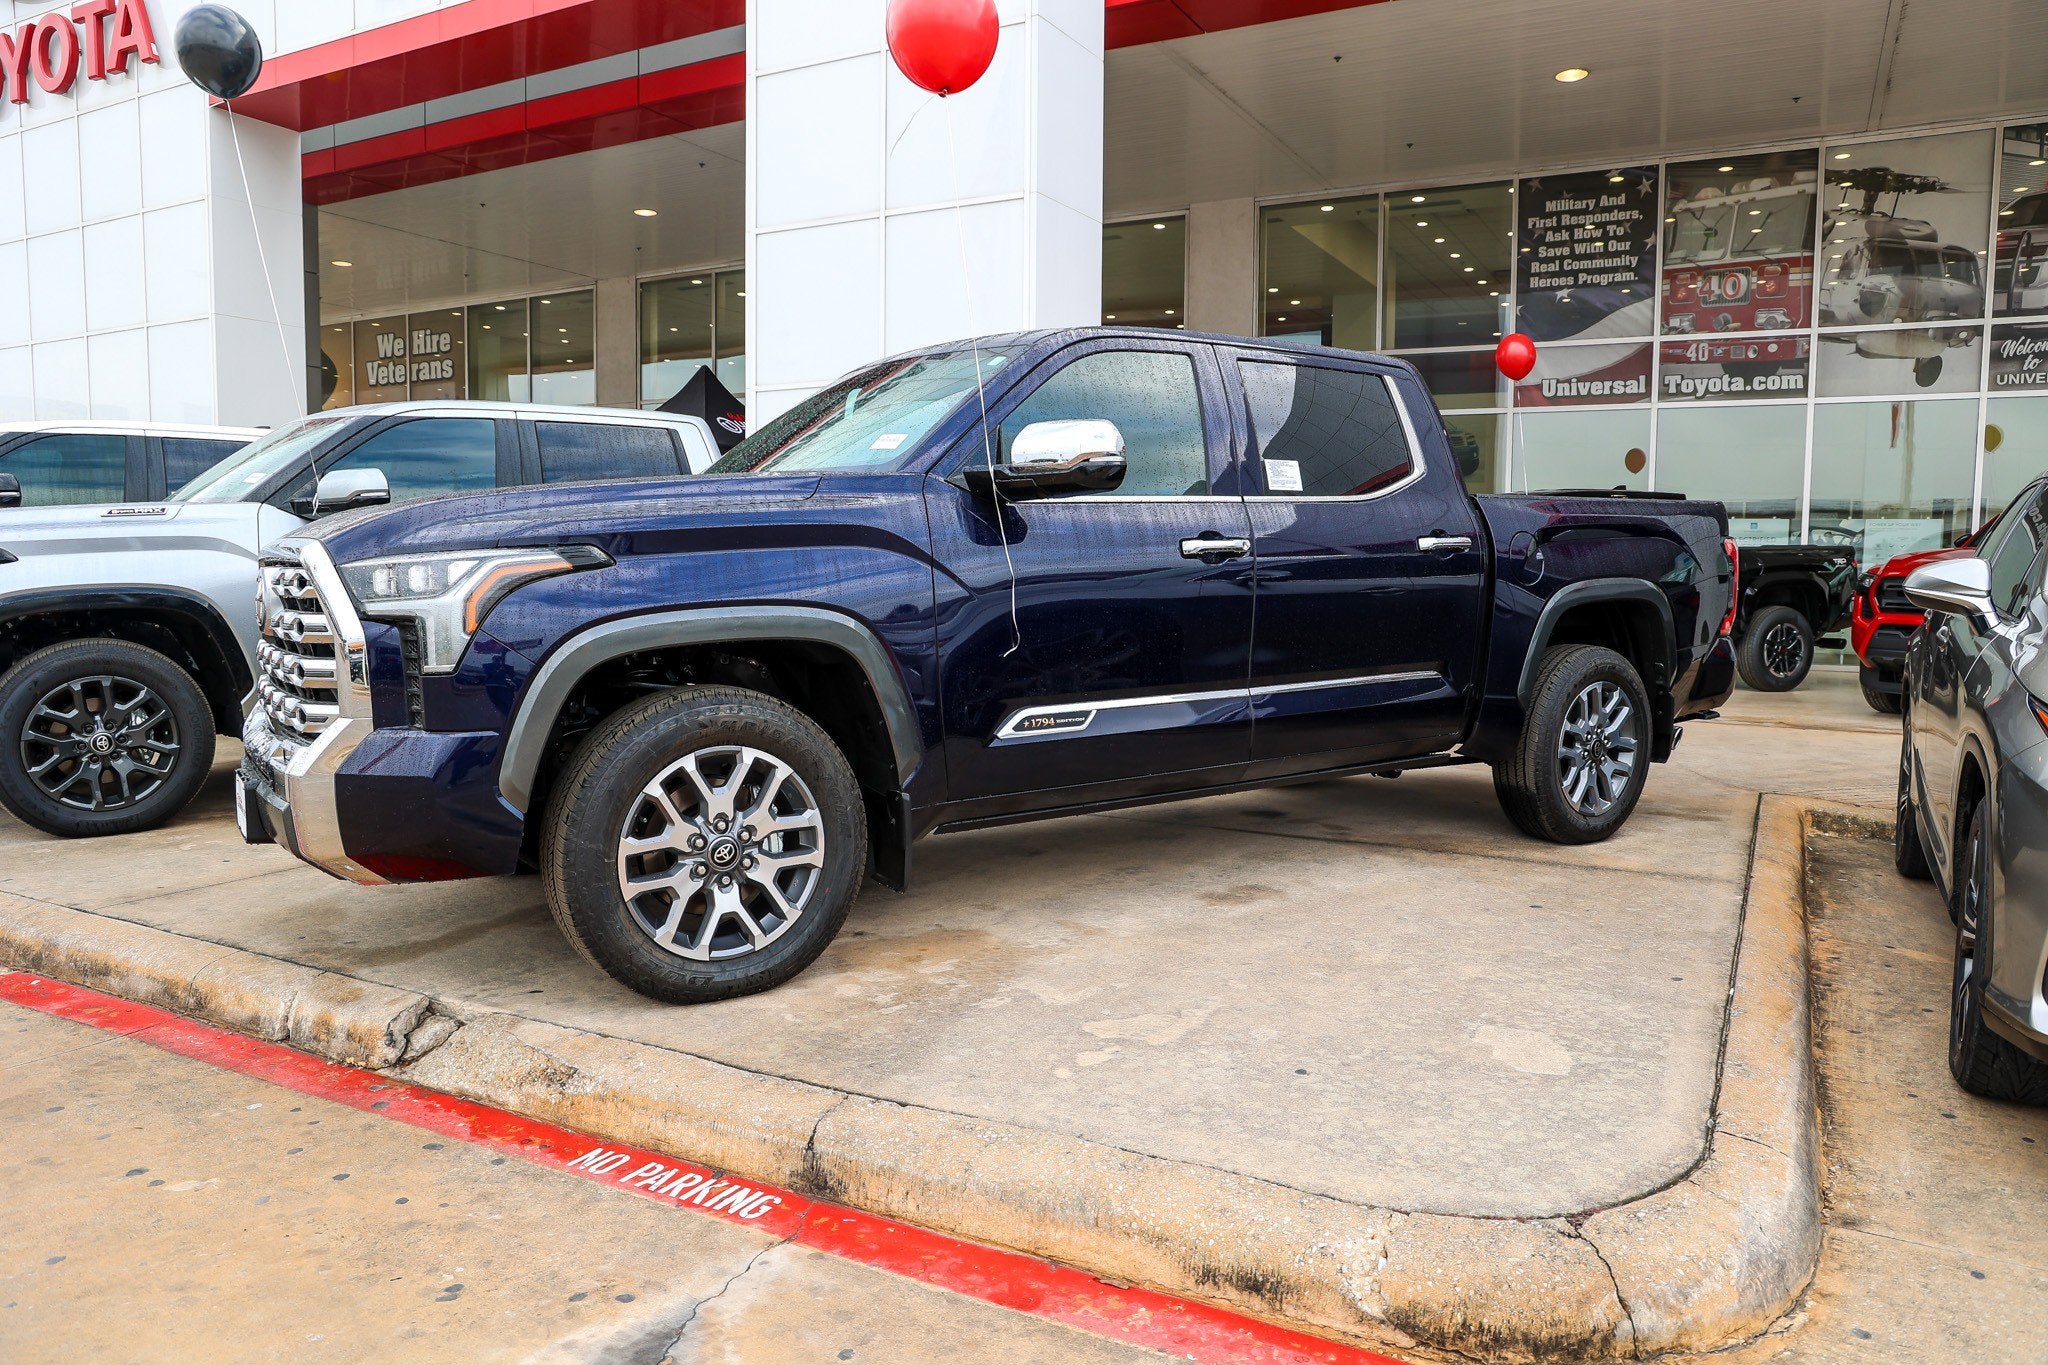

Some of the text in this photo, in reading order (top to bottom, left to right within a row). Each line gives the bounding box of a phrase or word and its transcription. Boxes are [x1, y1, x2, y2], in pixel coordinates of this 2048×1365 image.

[0, 0, 160, 104] YOTA
[1545, 193, 1626, 212] Military And
[1528, 208, 1643, 229] First Responders,
[1545, 224, 1625, 242] Ask How To
[1538, 240, 1632, 258] Save With Our
[1531, 255, 1639, 273] Real Community
[1529, 271, 1639, 288] Heroes Program.
[1697, 272, 1748, 301] 40
[376, 329, 451, 358] We Hire
[1686, 343, 1709, 362] 40
[2023, 354, 2043, 370] to
[366, 359, 453, 386] Veterans
[1996, 373, 2048, 385] UNIVE
[1541, 373, 1804, 398] Universal Toyota.com
[1031, 717, 1055, 728] 1794
[567, 1147, 782, 1219] NO PARKING
